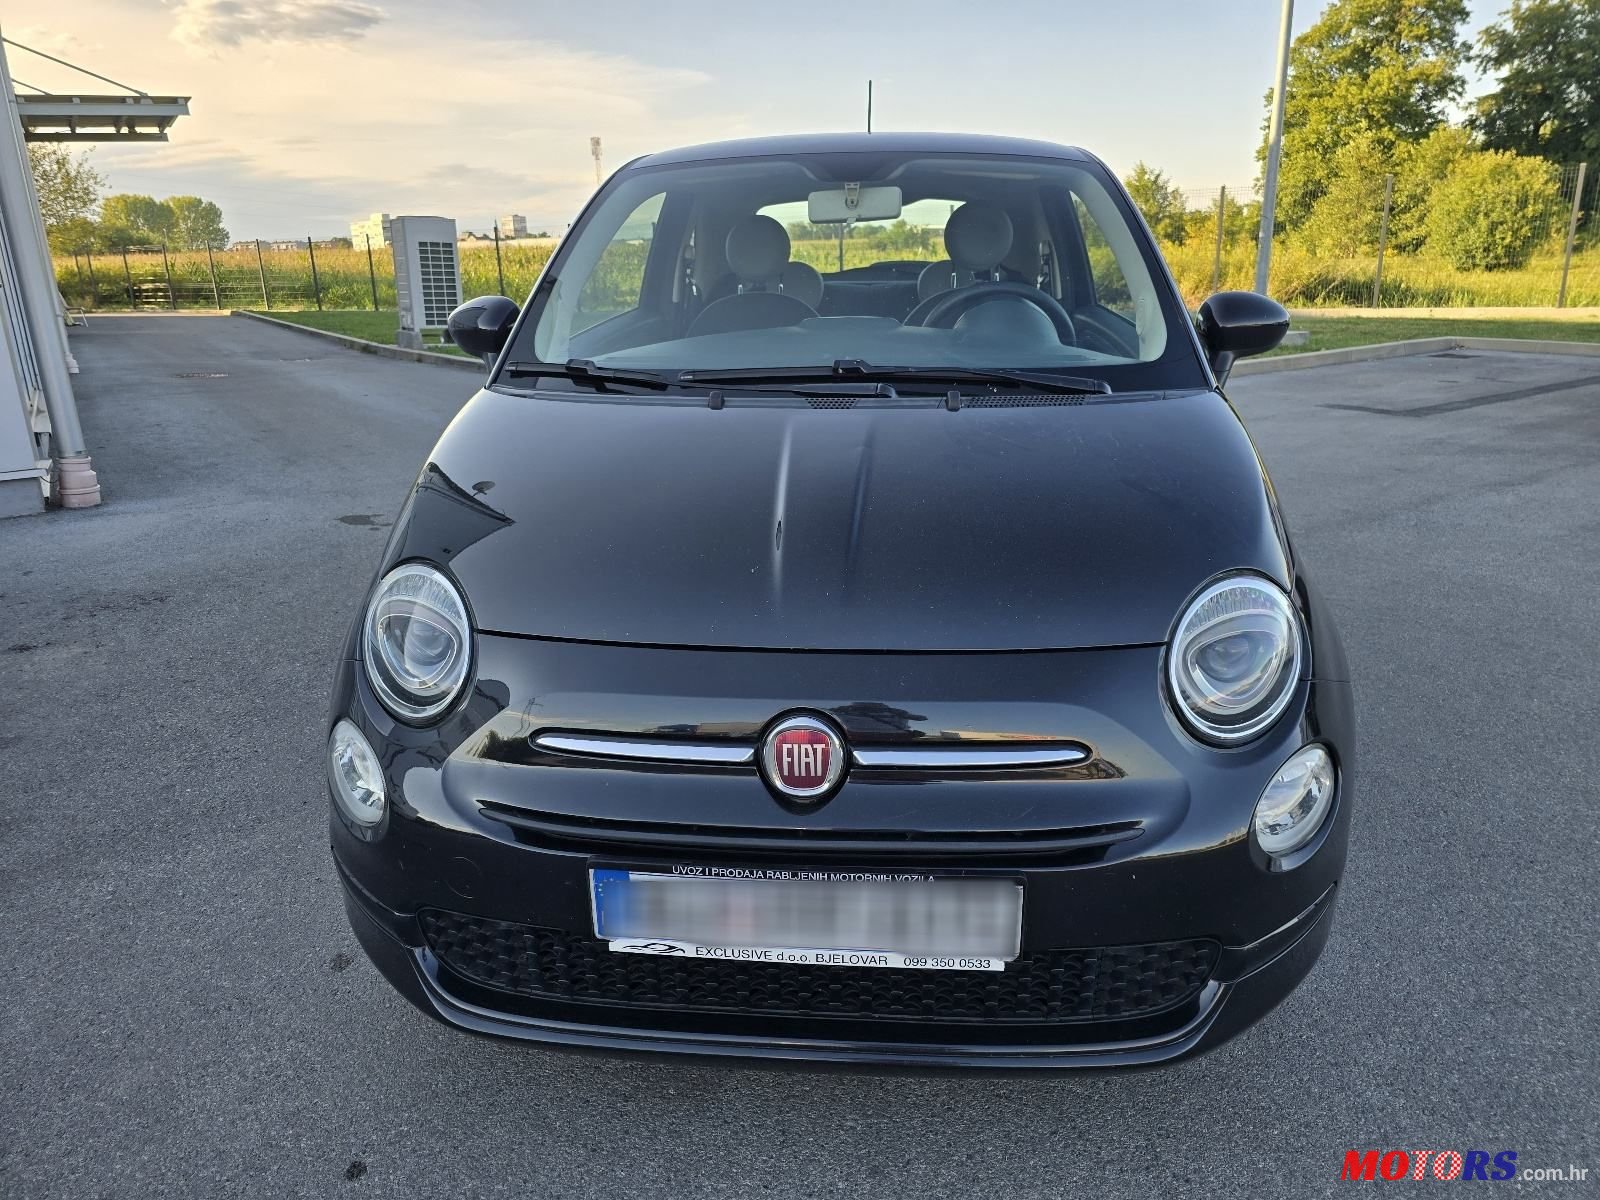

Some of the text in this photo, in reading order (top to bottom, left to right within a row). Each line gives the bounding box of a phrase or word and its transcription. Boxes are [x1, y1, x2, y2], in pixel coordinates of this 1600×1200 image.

[782, 743, 826, 776] FIAT
[672, 865, 703, 875] UVOZ
[712, 868, 764, 879] PRODAJA
[766, 871, 828, 881] RABLJENIH
[830, 873, 891, 882] MOTORNIH
[695, 947, 991, 969] EXCLUSIVE d.o.o. BJELOVAR 099 350 0533
